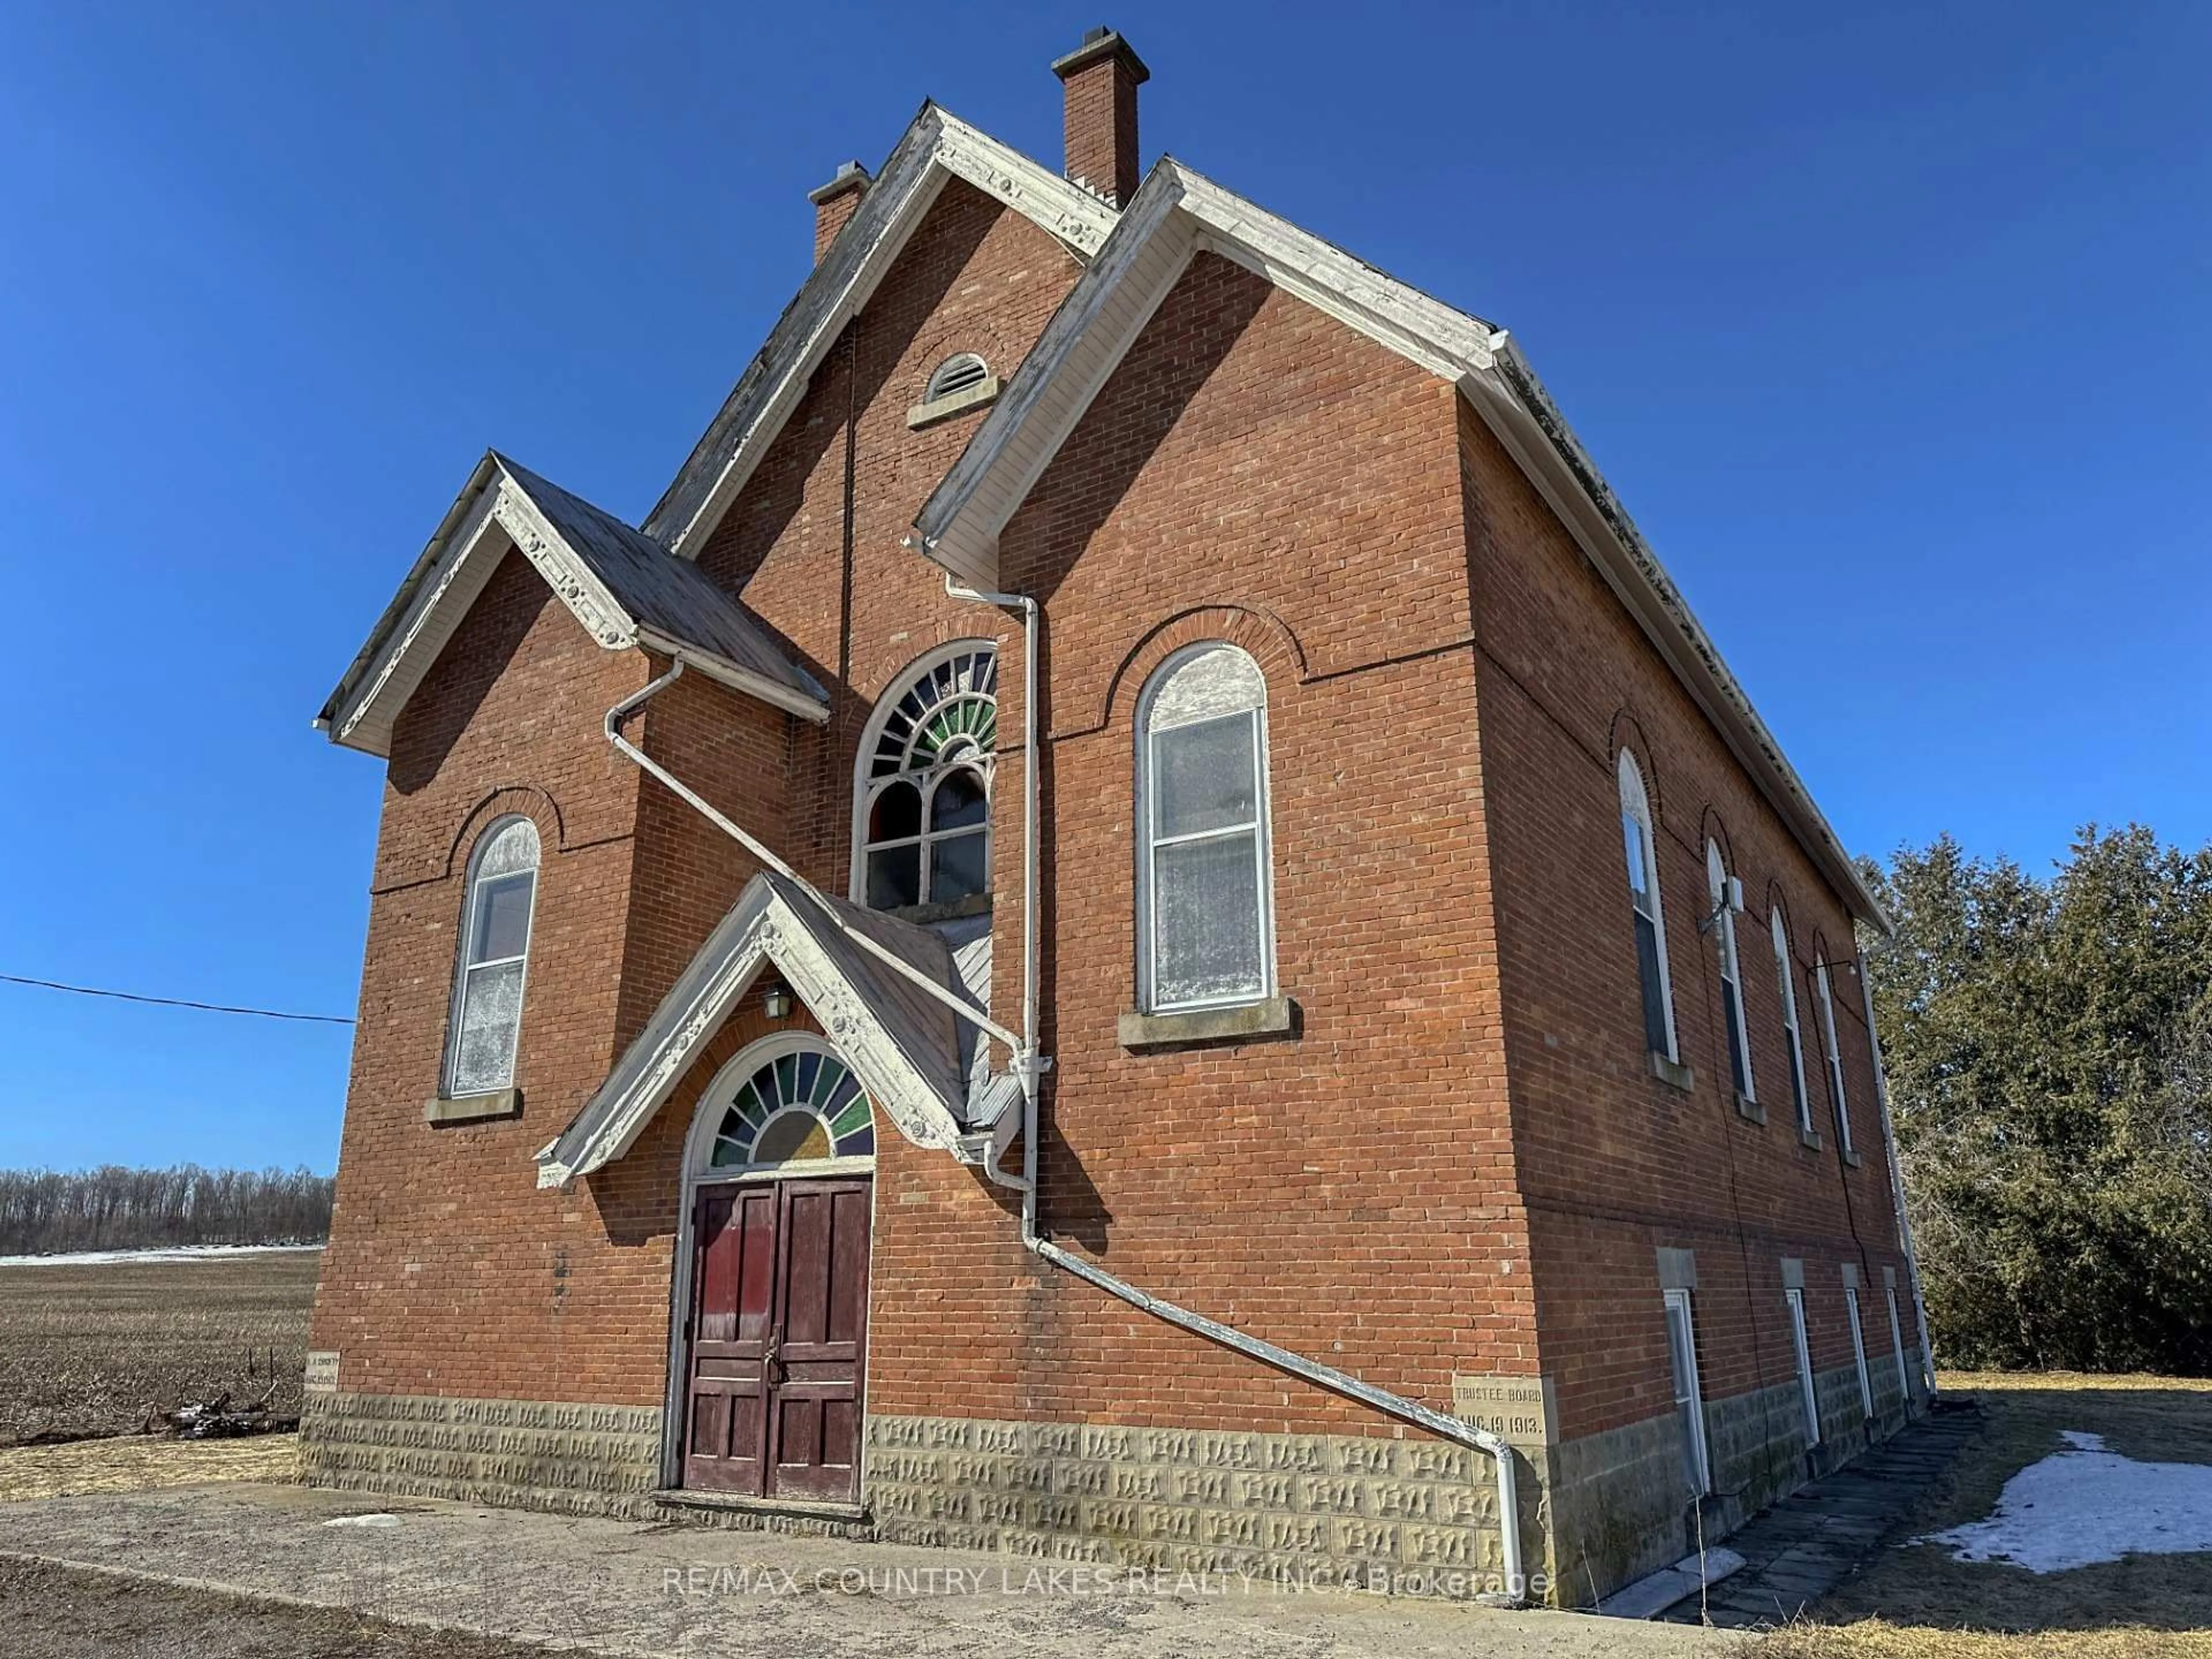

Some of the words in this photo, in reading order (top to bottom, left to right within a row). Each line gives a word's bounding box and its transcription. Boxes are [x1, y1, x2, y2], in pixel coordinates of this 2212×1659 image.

[1456, 1387, 1503, 1401] TRUSTEE
[1508, 1388, 1541, 1402] BOARD
[1491, 1416, 1503, 1432] 19
[1509, 1416, 1542, 1434] 1913.
